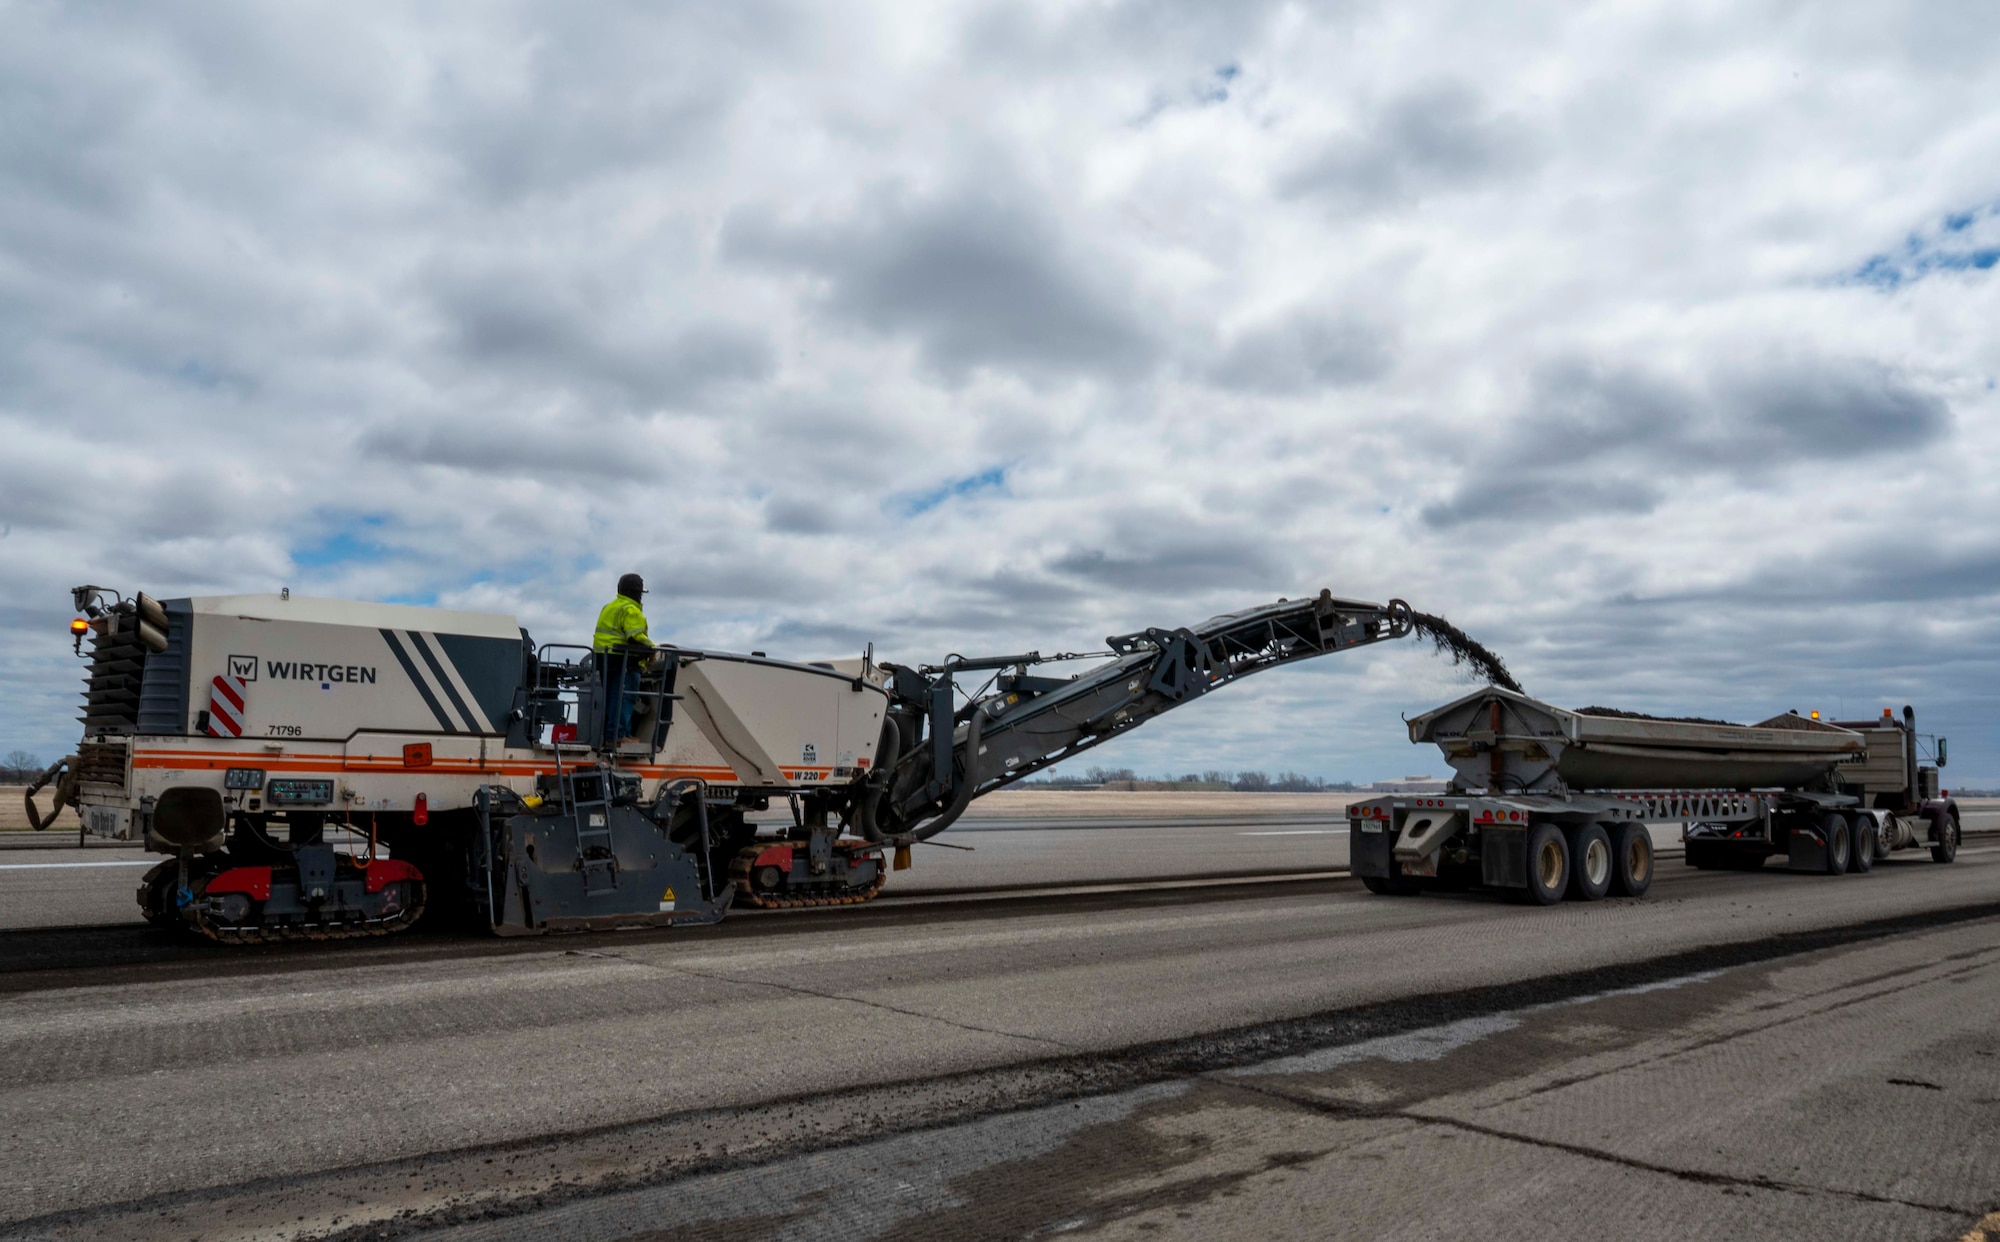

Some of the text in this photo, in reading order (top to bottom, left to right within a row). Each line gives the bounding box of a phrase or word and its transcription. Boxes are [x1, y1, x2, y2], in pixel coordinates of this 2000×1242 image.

[267, 661, 376, 684] WIRTGEN
[268, 725, 301, 736] 71796
[794, 772, 819, 781] W 220
